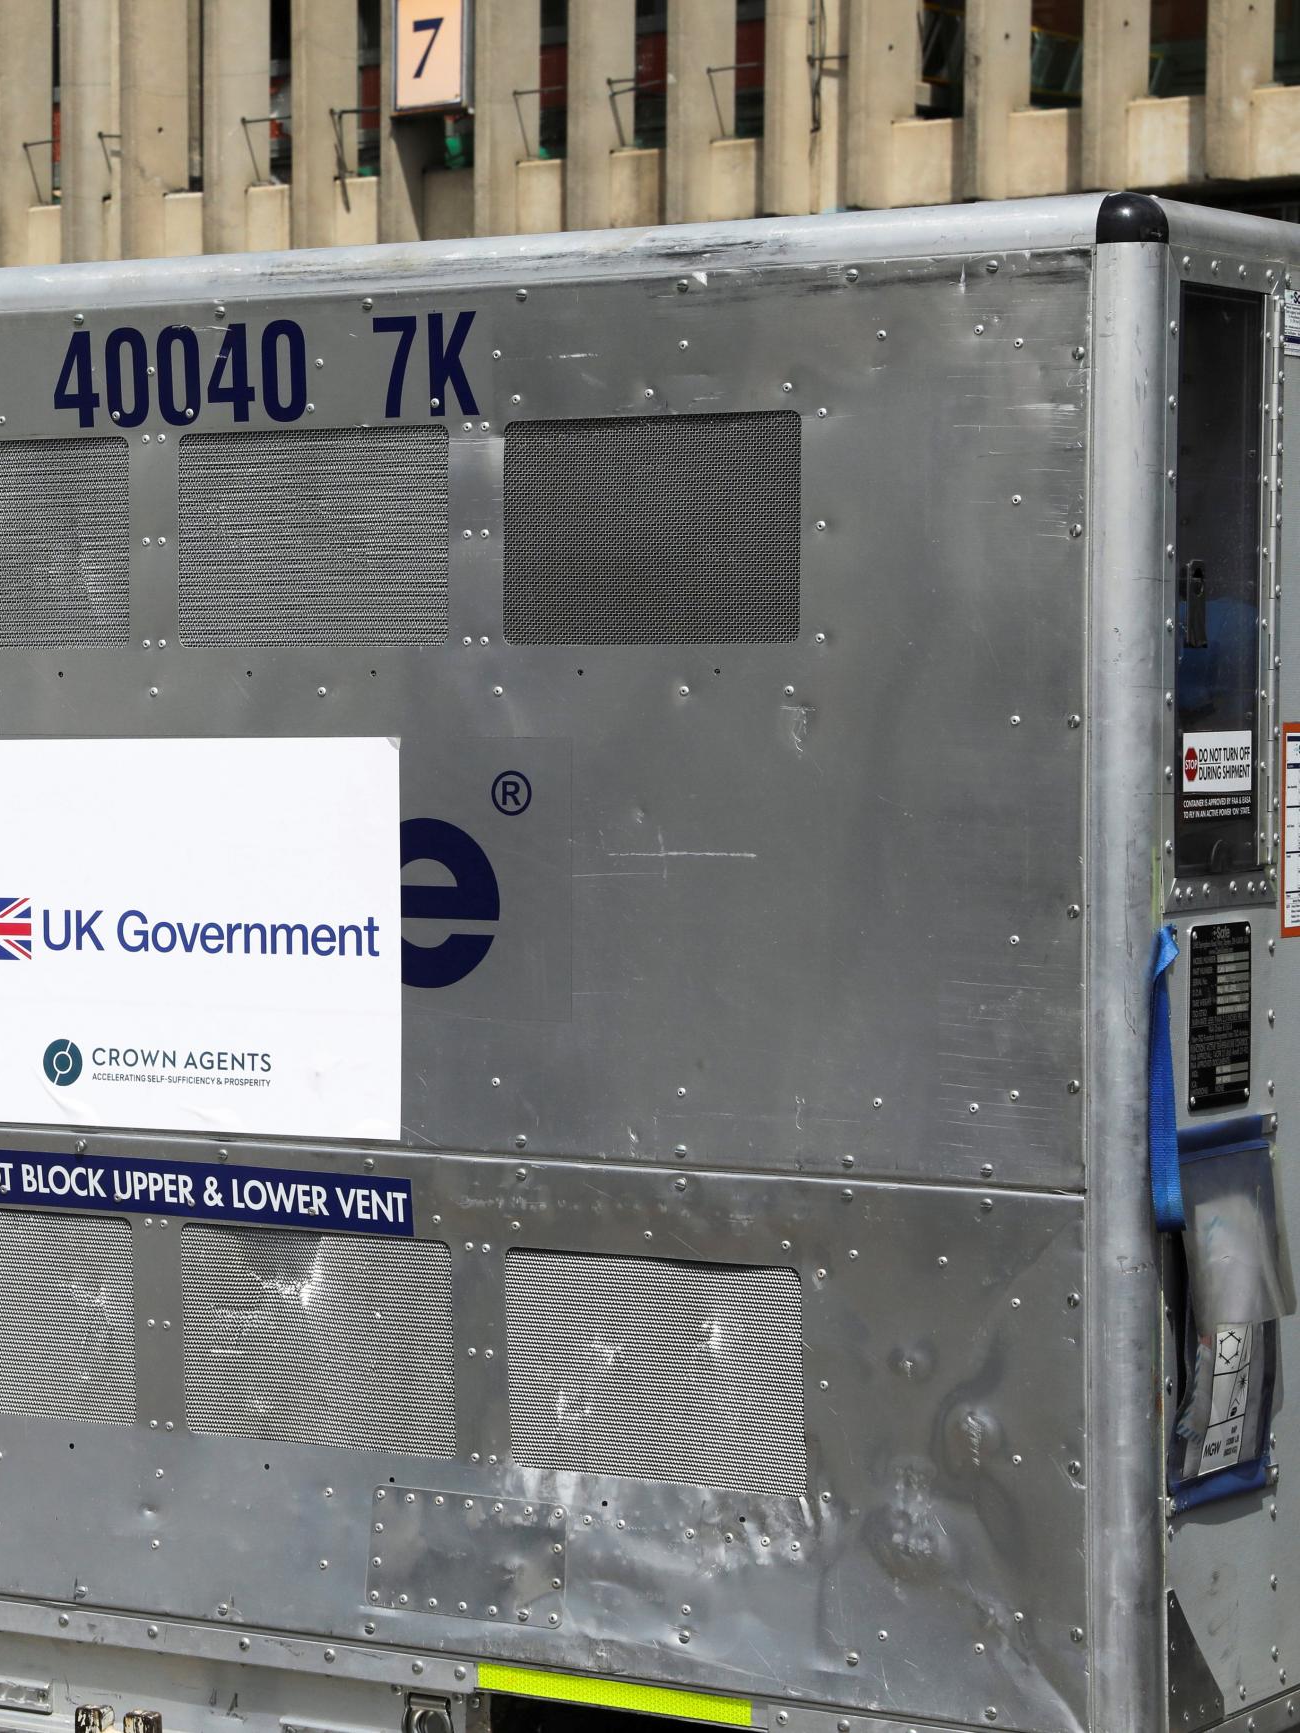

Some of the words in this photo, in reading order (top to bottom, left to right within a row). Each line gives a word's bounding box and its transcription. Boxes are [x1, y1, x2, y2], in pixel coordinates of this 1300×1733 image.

[413, 17, 444, 79] 7
[53, 318, 307, 428] 40040
[372, 311, 480, 419] 7K
[1185, 760, 1198, 770] STOP
[1199, 748, 1209, 763] DO
[1209, 747, 1222, 762] NOT
[1223, 747, 1239, 761] TURN
[1240, 746, 1250, 760] OFF
[1199, 766, 1222, 780] DURING
[1222, 764, 1250, 779] SHIPMENT
[43, 909, 104, 952] UK
[116, 909, 381, 957] Government
[92, 1047, 176, 1069] CROWN
[184, 1051, 272, 1073] AGENTS
[92, 1072, 146, 1083] ACCELERATING
[147, 1074, 216, 1085] SELF-SUFFICIENCY
[216, 1077, 223, 1086] &
[224, 1077, 271, 1087] PROSPERITY
[22, 1163, 106, 1199] BLOCK
[114, 1169, 195, 1207] UPPER
[203, 1176, 225, 1207] &
[232, 1178, 329, 1217] LOWER
[335, 1187, 408, 1223] VENT
[1203, 1440, 1221, 1459] MGW
